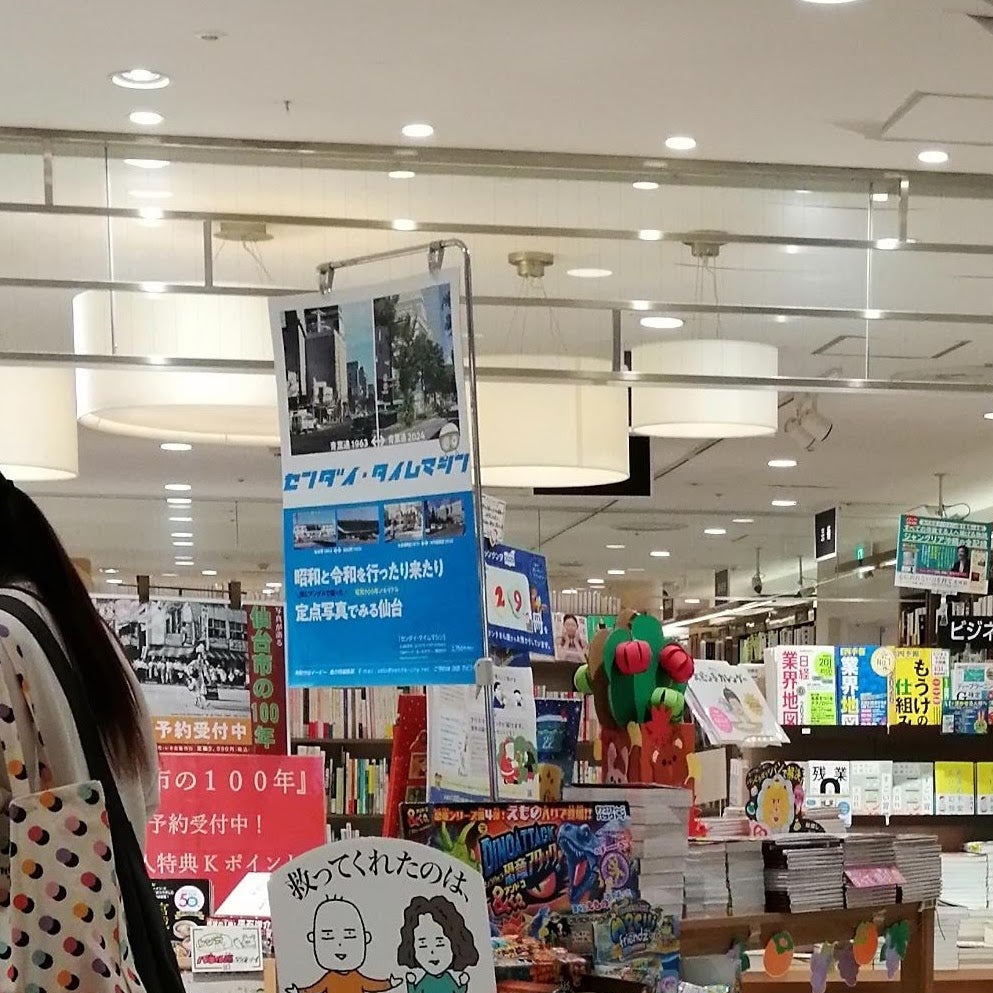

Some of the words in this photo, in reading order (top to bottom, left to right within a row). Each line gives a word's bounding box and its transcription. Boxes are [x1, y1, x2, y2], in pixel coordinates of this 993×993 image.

[293, 558, 444, 588] 昭和と令和を行ったり来たり
[295, 597, 404, 623] 定点写真でみる仙台
[250, 605, 279, 749] 仙台市の100年
[782, 650, 799, 726] 業界地図
[914, 659, 931, 726] もうけの
[155, 720, 247, 741] 予約受付中
[287, 848, 469, 902] 救ってくれたのは、
